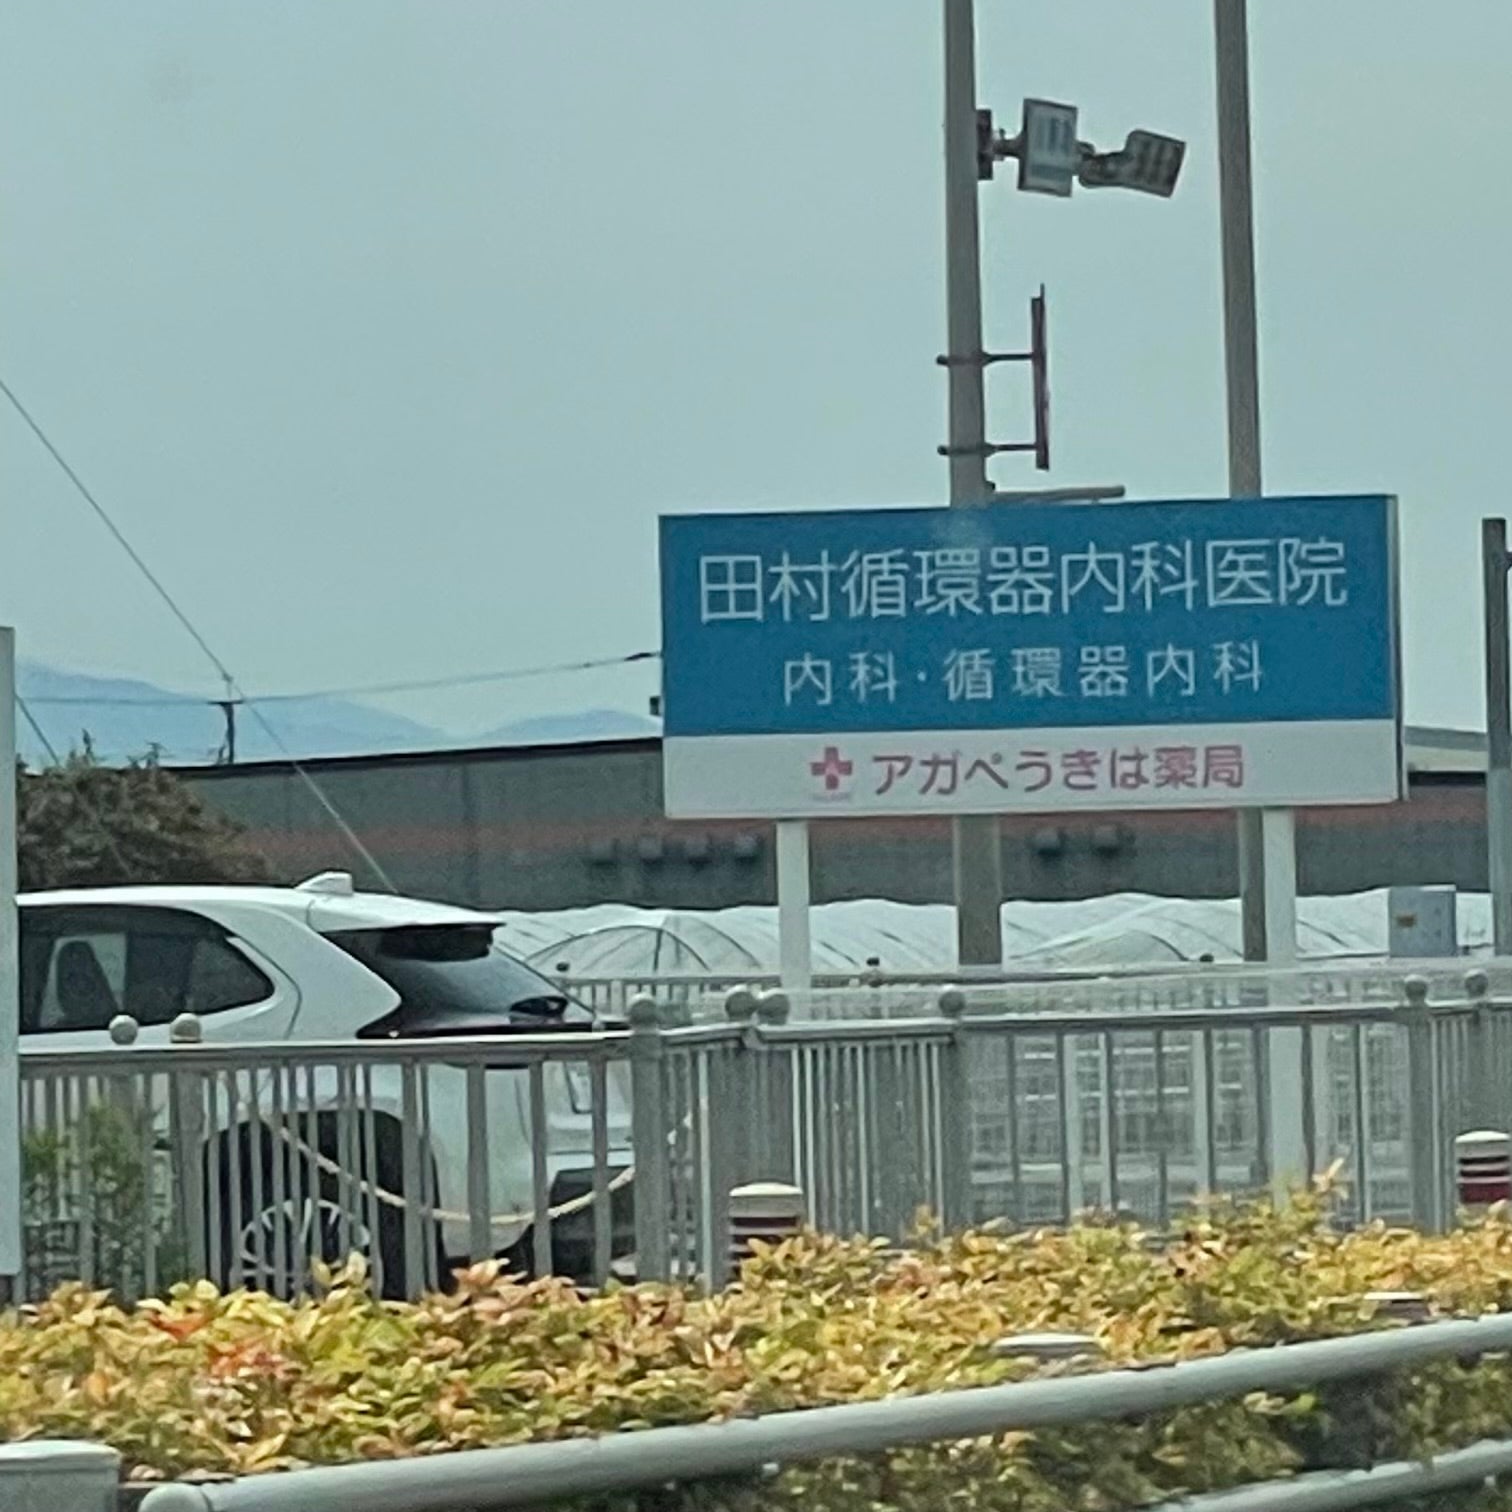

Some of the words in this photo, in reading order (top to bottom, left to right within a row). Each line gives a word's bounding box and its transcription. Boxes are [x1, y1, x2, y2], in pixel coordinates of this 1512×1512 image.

[700, 537, 1348, 624] 田村循環器内科医院
